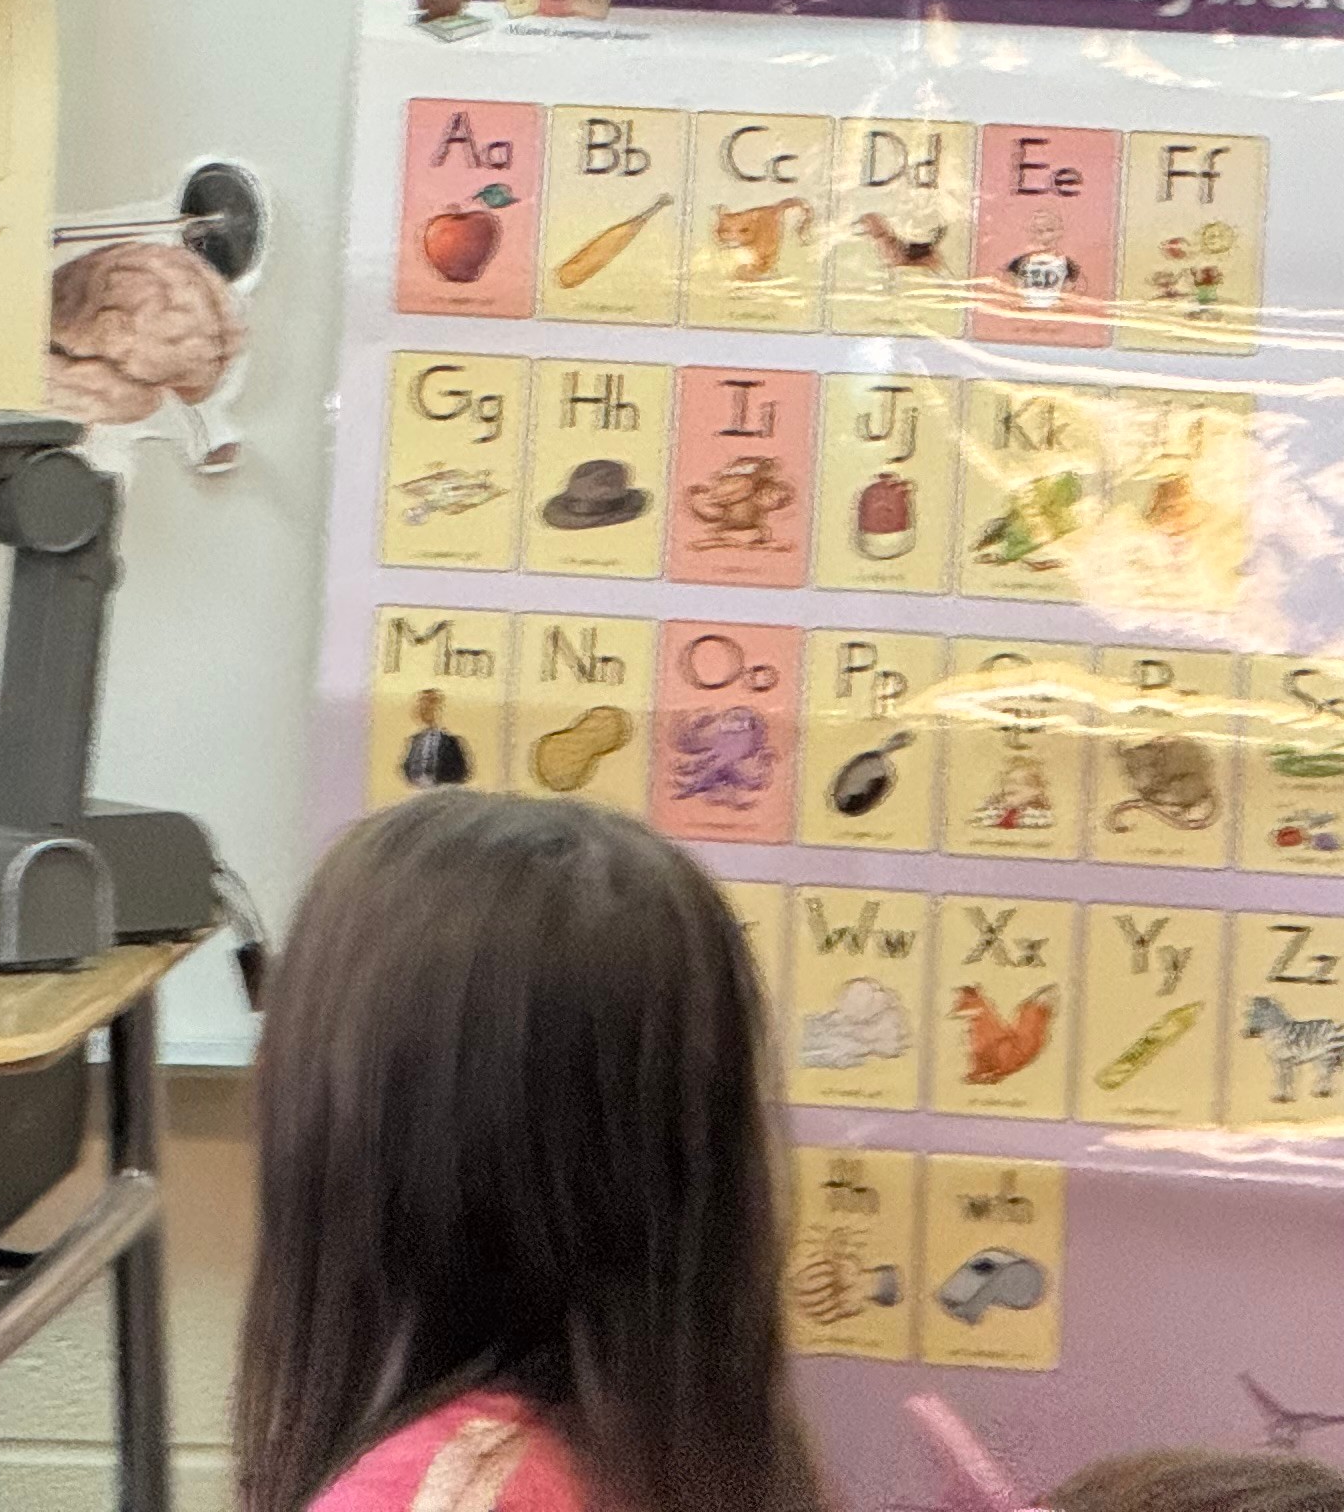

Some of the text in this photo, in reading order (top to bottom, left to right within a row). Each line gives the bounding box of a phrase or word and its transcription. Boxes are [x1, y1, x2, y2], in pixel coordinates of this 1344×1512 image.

[431, 112, 513, 170] Aa
[580, 118, 651, 176] Bb
[720, 126, 799, 182] Cc
[862, 130, 941, 188] Dd
[1014, 137, 1082, 196] Ee
[1158, 146, 1231, 203] Ff
[411, 365, 504, 443] Gg
[560, 371, 640, 431] Hh
[856, 386, 919, 464] Jj
[383, 617, 494, 678] Mm
[539, 624, 625, 685] Nn
[679, 634, 779, 691] Oo
[835, 641, 909, 719] Pp
[1113, 915, 1193, 996] Yy
